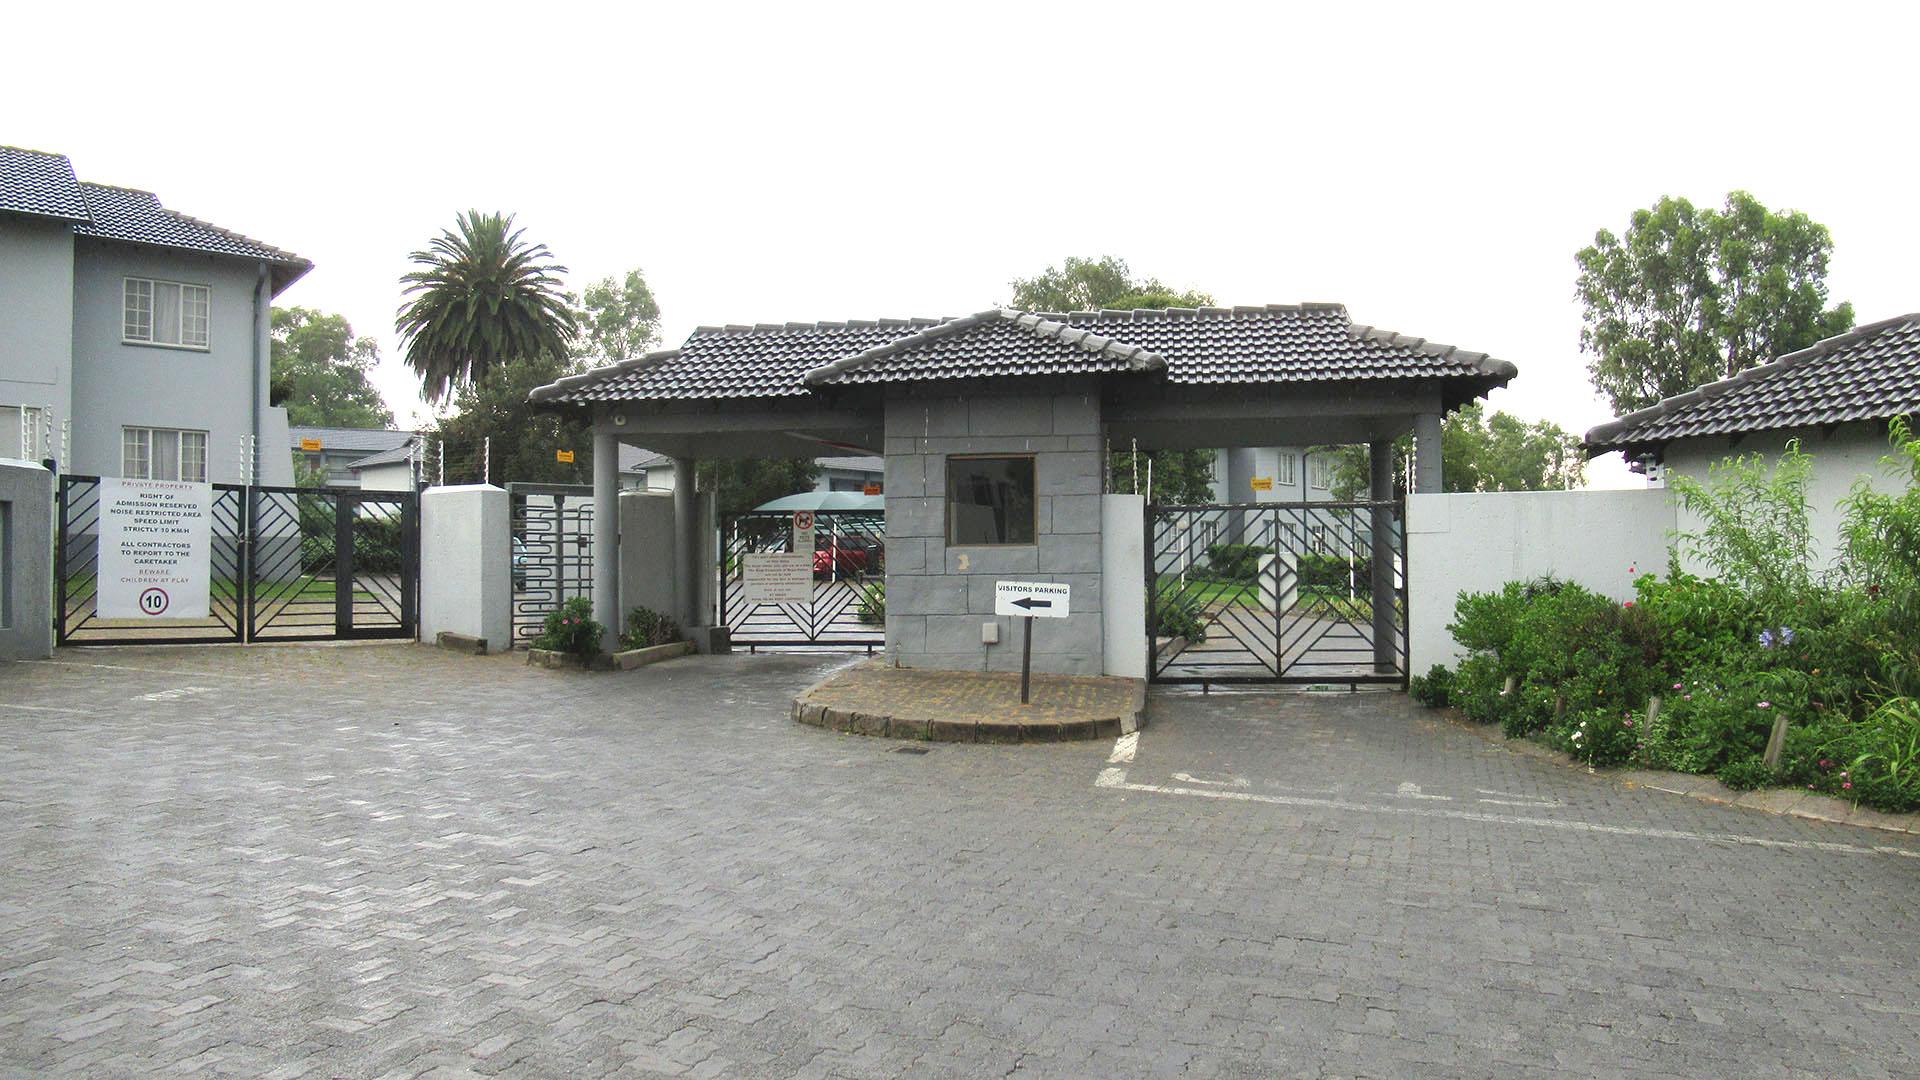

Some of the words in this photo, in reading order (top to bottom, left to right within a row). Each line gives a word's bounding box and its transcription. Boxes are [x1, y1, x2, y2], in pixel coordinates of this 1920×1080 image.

[998, 585, 1033, 593] VISITORS
[1034, 587, 1068, 595] PARKING
[145, 595, 162, 608] 10
